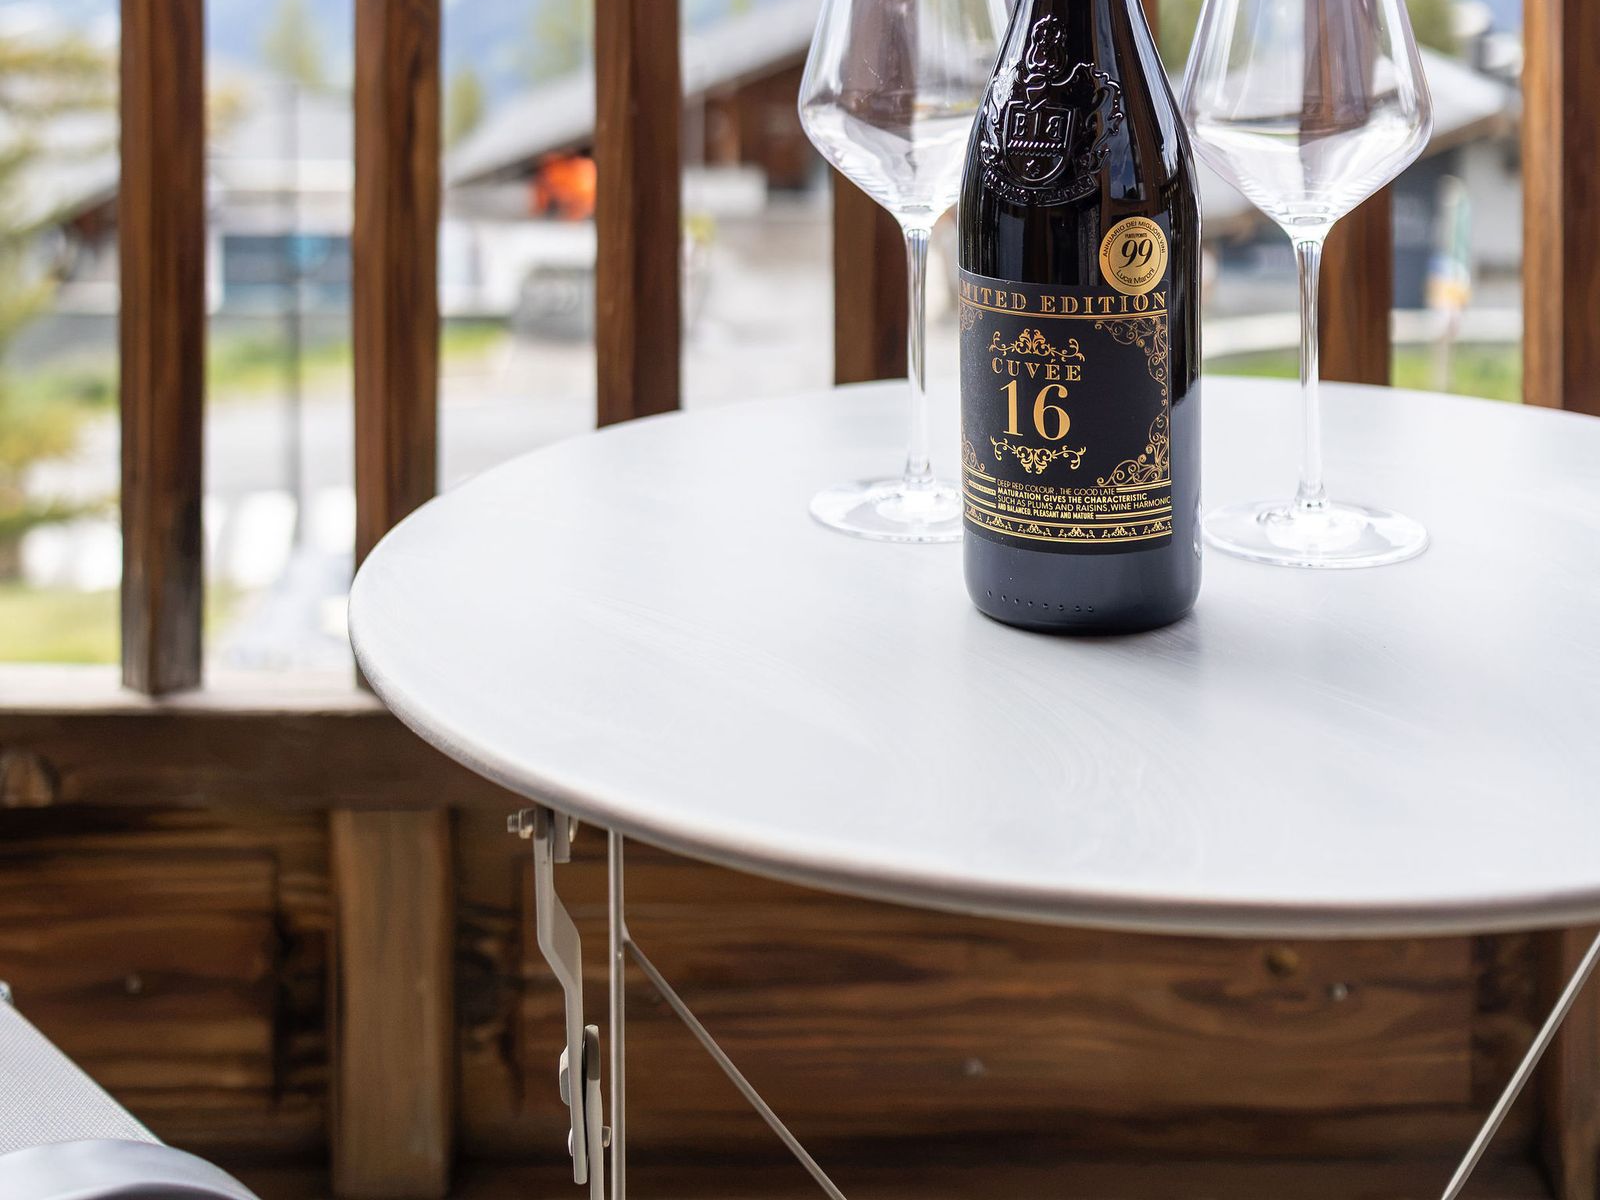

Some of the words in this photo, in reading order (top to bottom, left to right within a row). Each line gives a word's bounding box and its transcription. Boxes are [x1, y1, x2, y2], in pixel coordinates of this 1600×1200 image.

[1119, 238, 1153, 269] 99
[1116, 269, 1133, 283] Luca
[1134, 267, 1155, 284] Maroni
[960, 278, 1026, 310] MITED
[1040, 291, 1166, 313] EDITION
[992, 357, 1081, 381] CUVÉE
[1000, 380, 1071, 440] 16
[997, 479, 1011, 488] DEEP
[1011, 482, 1024, 491] RED
[1060, 487, 1072, 495] THE
[1074, 488, 1098, 496] GOOD
[1100, 487, 1115, 496] LATE
[997, 487, 1041, 500] MATURATION
[1043, 494, 1066, 503] GIVES
[1069, 496, 1082, 504] THE
[1084, 493, 1148, 504] CHARACTERISTIC
[997, 495, 1016, 505] SUCH
[1016, 499, 1026, 507] AS
[1027, 501, 1053, 510] PLUMS
[1055, 503, 1074, 512] AND
[1133, 495, 1171, 508] HARMONIC
[1033, 509, 1059, 518] PLEASANT
[1060, 511, 1072, 519] AND
[1072, 512, 1094, 520] MATURE
